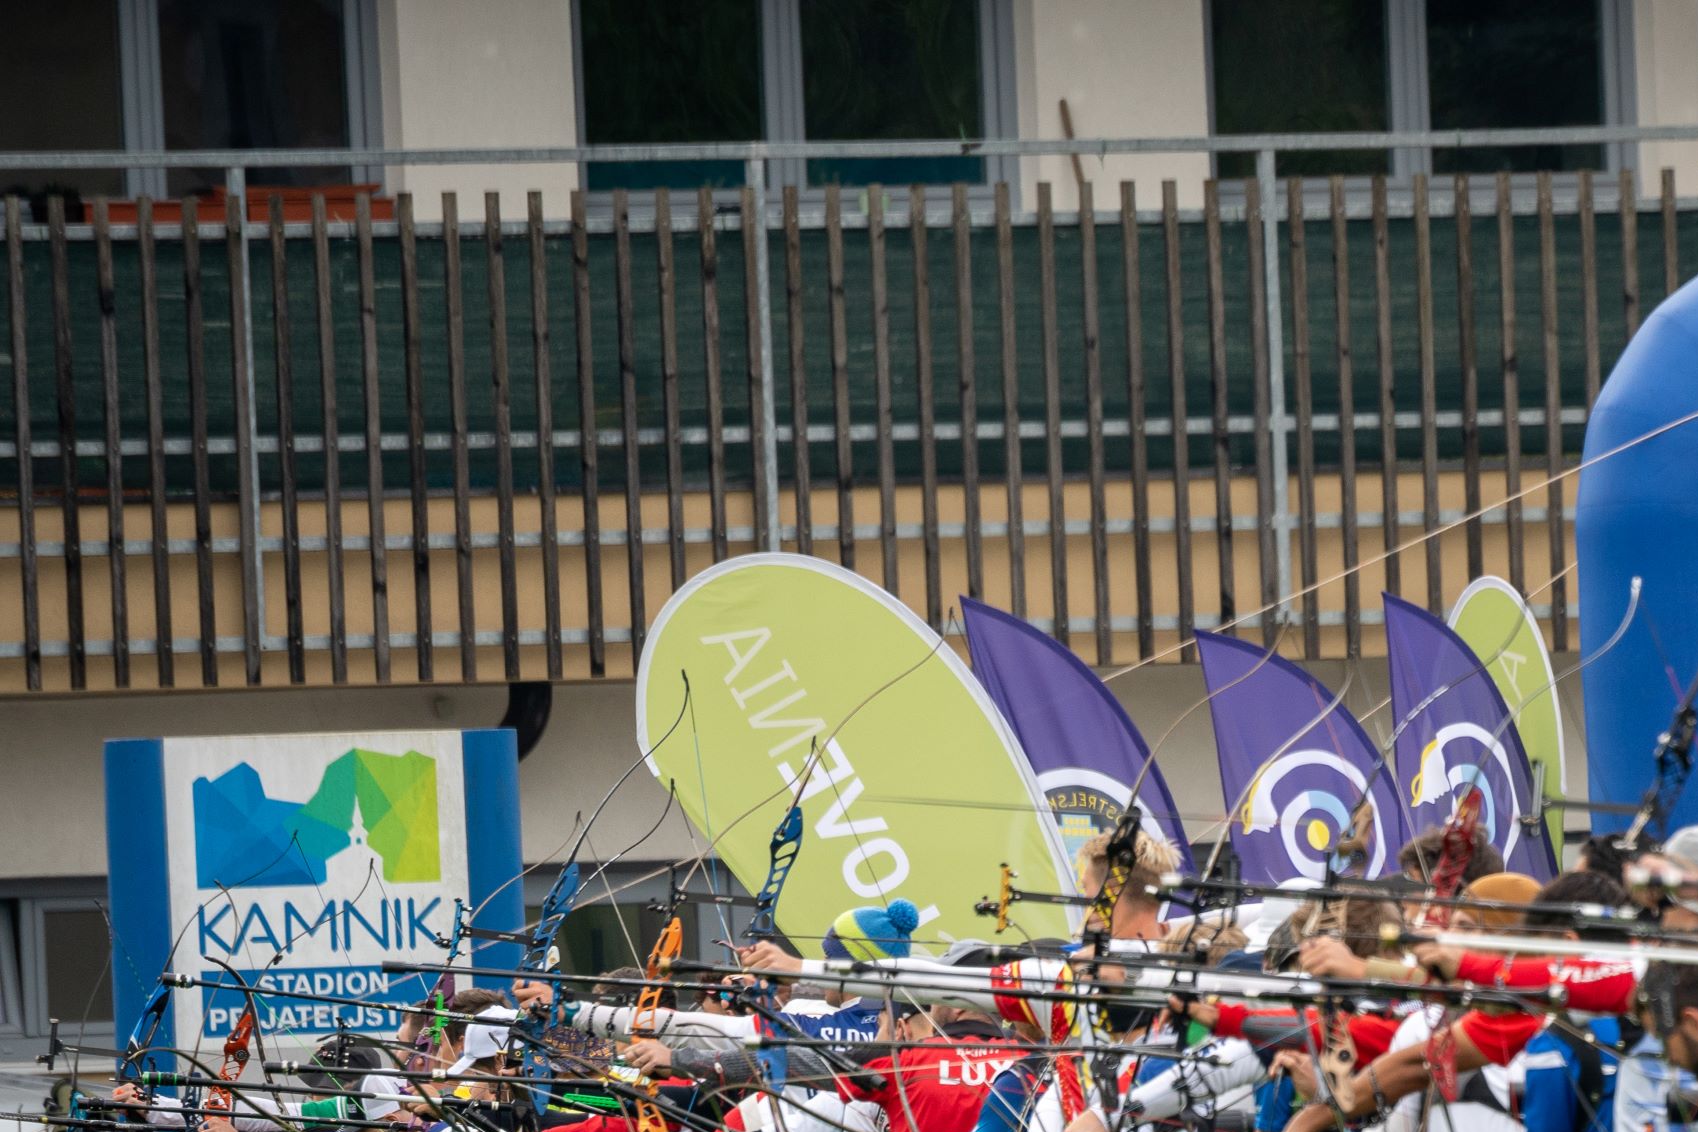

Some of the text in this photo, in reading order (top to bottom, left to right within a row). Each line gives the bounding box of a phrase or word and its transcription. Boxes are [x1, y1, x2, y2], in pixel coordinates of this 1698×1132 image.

[197, 896, 447, 956] KAMNIK
[258, 972, 389, 999] STADION
[210, 1001, 410, 1033] PRJATELJST
[939, 1059, 1016, 1086] LUX
